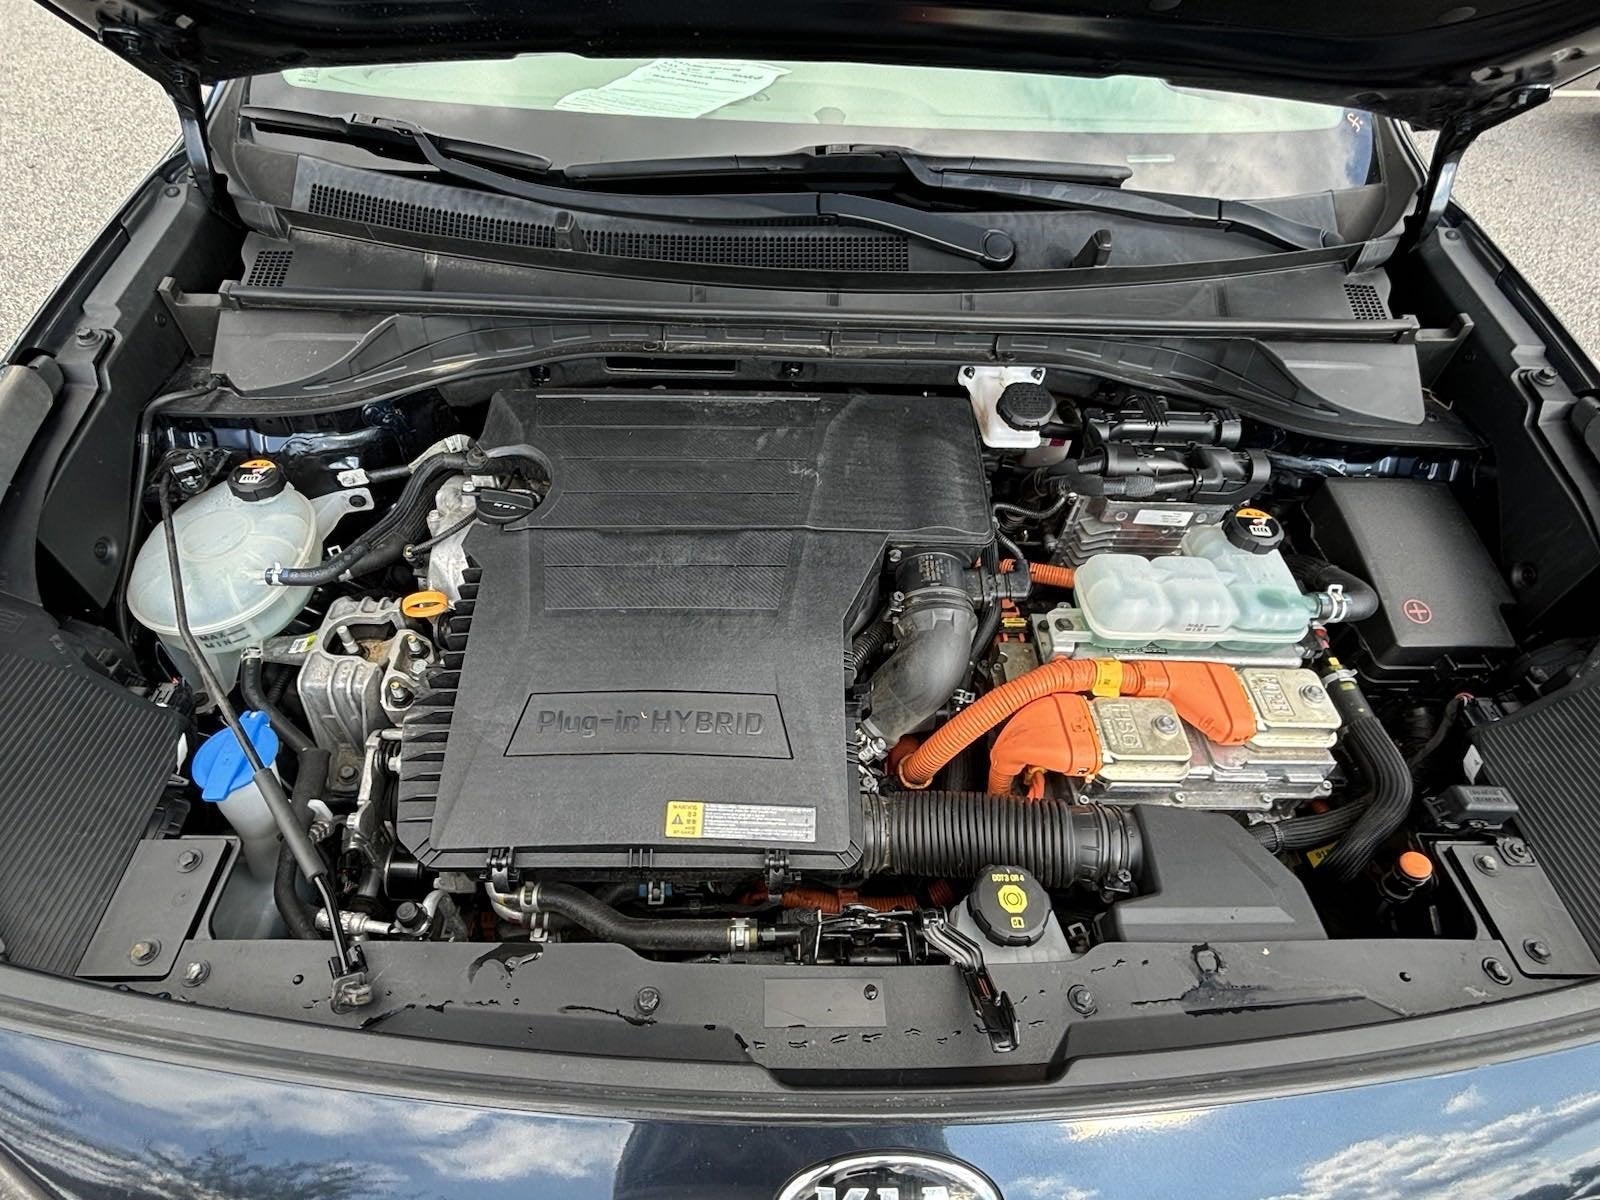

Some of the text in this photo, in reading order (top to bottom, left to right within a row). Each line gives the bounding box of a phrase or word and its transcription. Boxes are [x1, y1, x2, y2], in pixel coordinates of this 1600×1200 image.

[199, 631, 227, 641] MAX
[204, 638, 233, 648] MIN
[536, 709, 764, 738] Plug-in HYBRID
